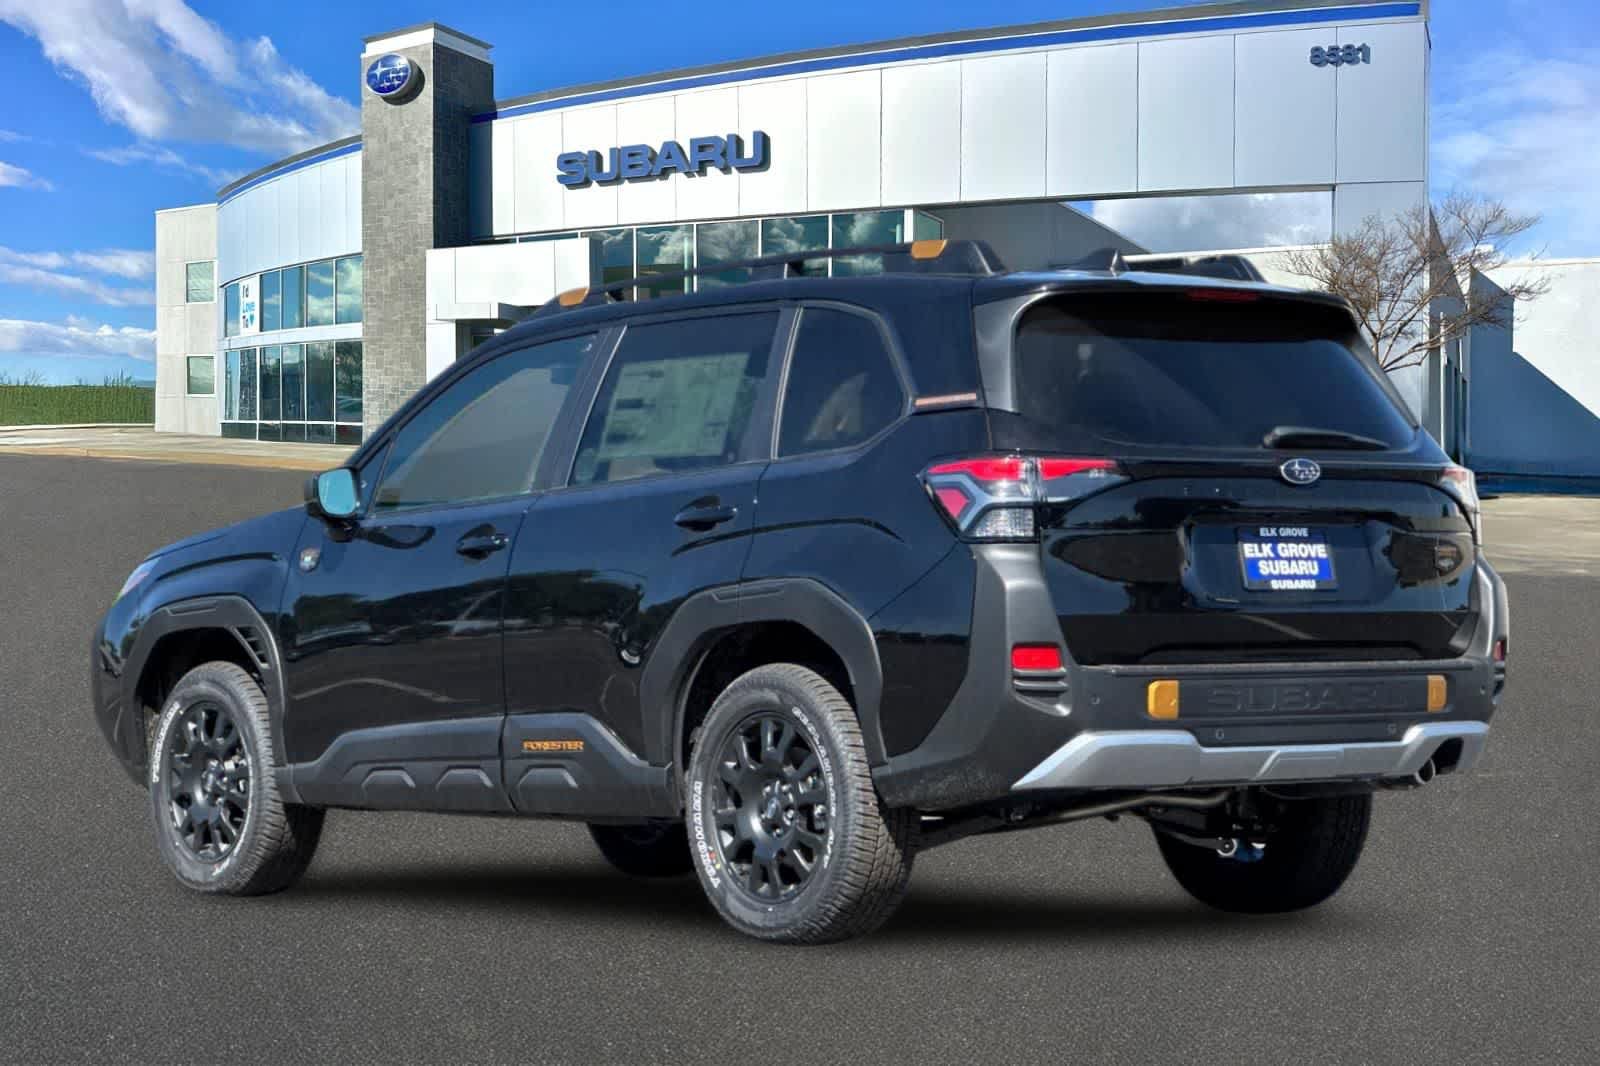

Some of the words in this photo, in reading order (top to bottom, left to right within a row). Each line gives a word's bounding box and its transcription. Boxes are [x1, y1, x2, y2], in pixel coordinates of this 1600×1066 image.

[556, 130, 771, 190] SUBARU
[1259, 527, 1277, 537] ELK
[1279, 527, 1308, 537] GROVE
[1243, 543, 1274, 558] ELK
[1277, 543, 1327, 558] GROVE
[1258, 560, 1319, 575] SUBARU
[1270, 579, 1316, 590] SUBARU
